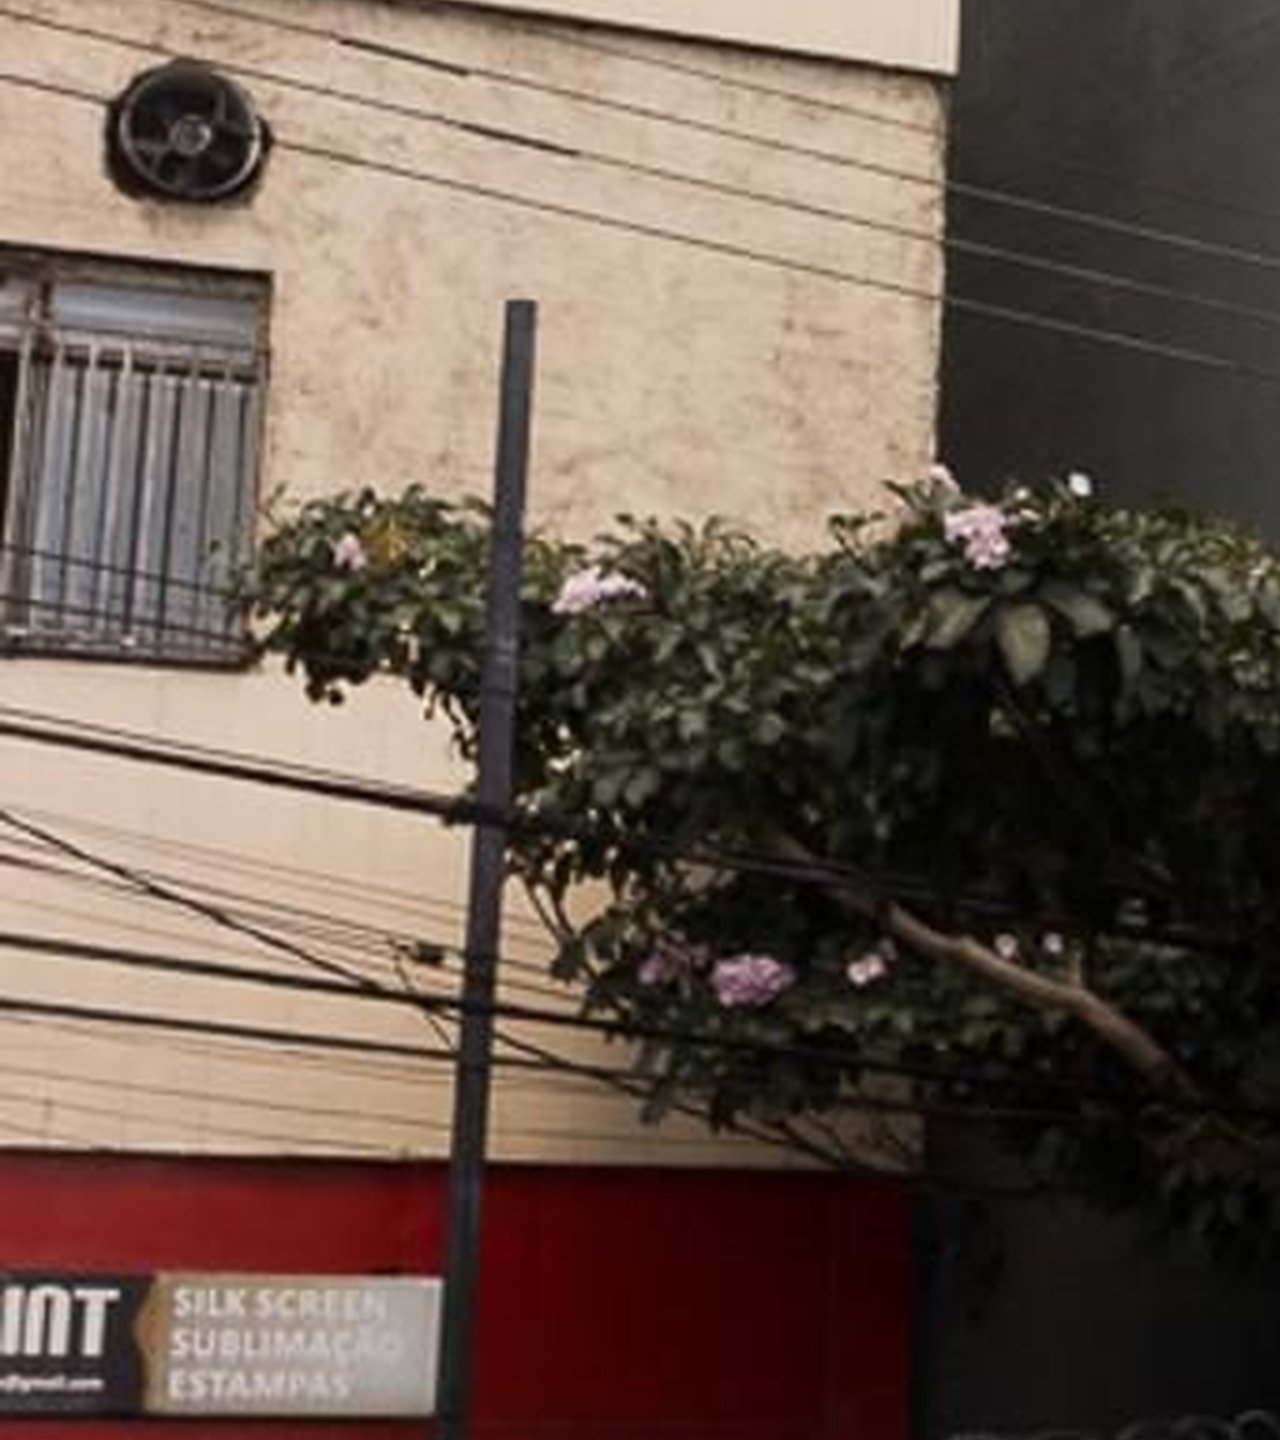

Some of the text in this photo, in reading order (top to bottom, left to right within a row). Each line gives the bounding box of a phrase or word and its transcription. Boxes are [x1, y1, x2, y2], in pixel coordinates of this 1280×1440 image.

[173, 1287, 388, 1320] SILK SCREEN
[0, 1286, 121, 1356] INT
[167, 1368, 350, 1400] ESTAMPAS
